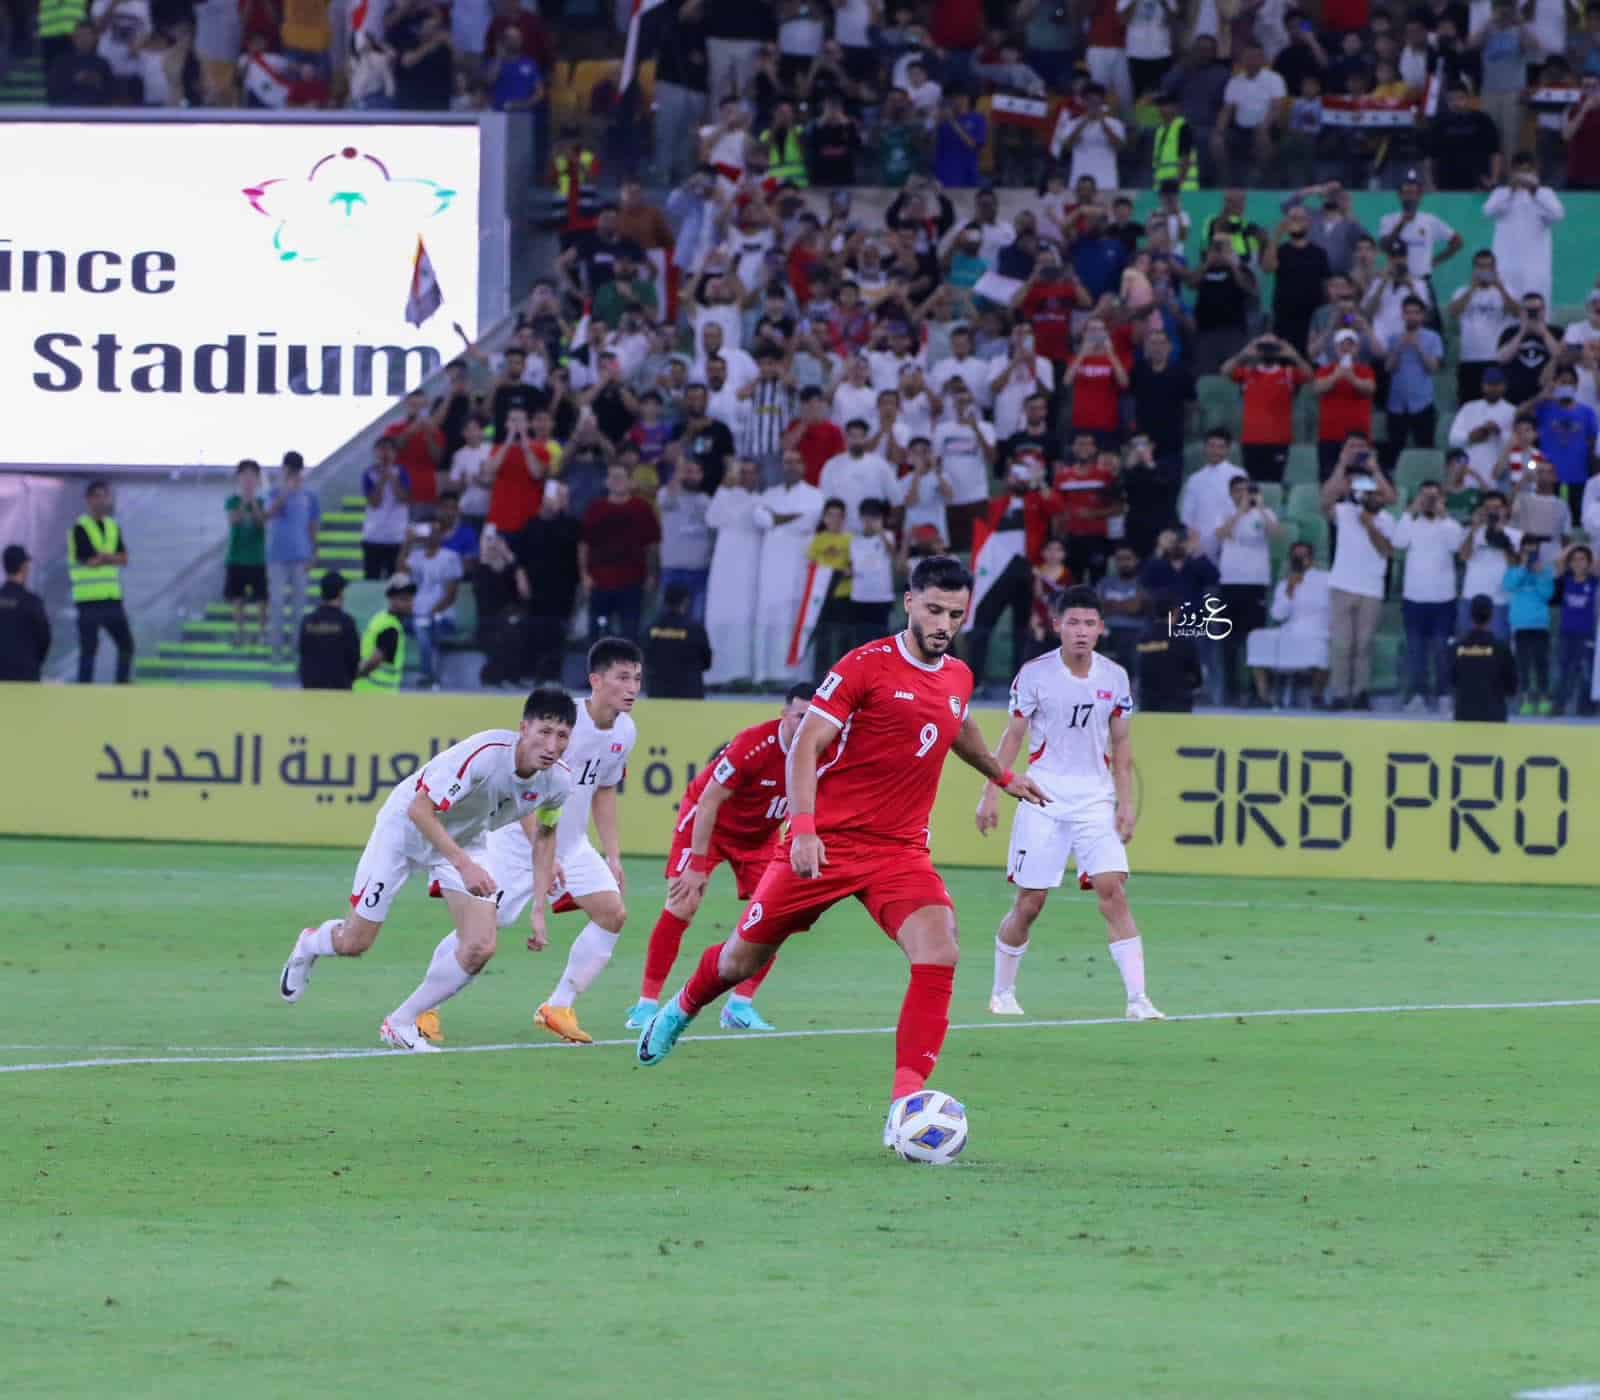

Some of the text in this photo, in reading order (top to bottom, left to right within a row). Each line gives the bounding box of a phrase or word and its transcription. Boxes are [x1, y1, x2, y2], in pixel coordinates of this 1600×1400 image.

[33, 332, 441, 396] Stadium
[1068, 703, 1094, 728] 17
[915, 722, 939, 758] 9
[96, 733, 457, 803] عربية الجديد
[577, 758, 601, 785] 14
[765, 796, 788, 819] 10
[1174, 746, 1569, 857] 3RB PRO
[365, 882, 384, 907] 3
[743, 902, 763, 930] 9
